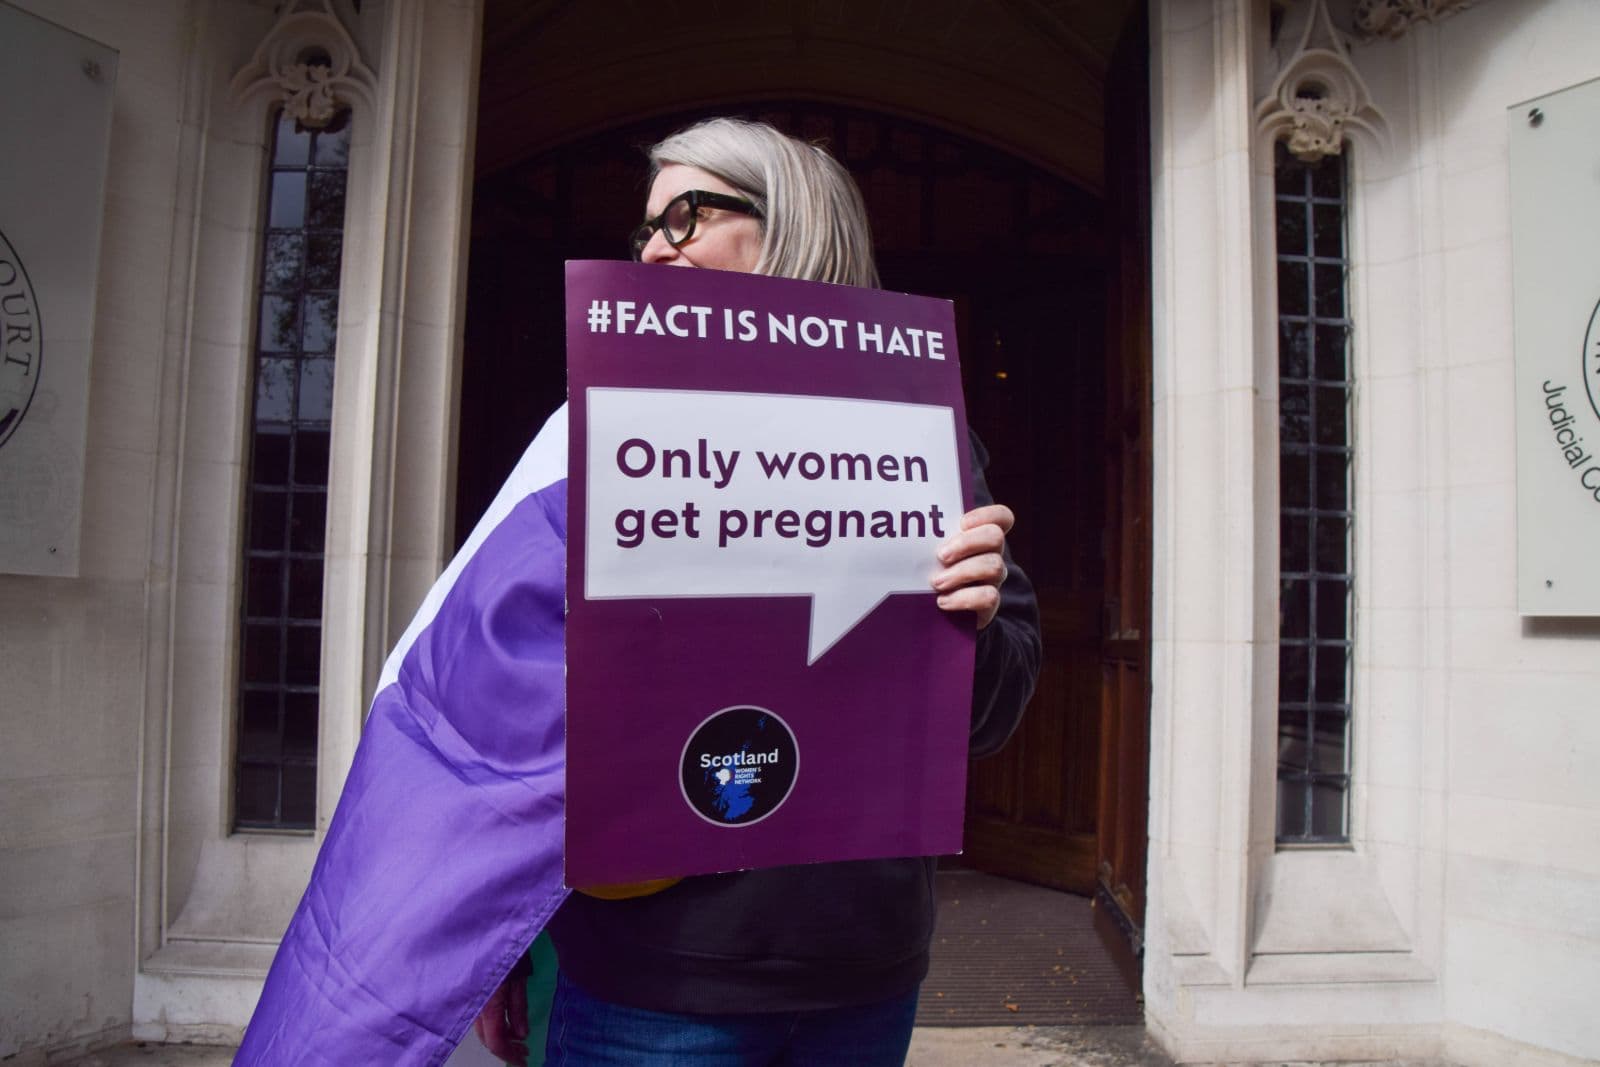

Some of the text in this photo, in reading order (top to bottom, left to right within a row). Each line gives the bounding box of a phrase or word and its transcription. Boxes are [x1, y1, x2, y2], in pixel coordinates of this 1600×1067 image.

[587, 300, 946, 361] #FACT IS NOT HATE
[1542, 380, 1592, 469] Judicial
[616, 438, 929, 489] Only women
[614, 502, 945, 549] get pregnant
[700, 748, 779, 768] Scotland
